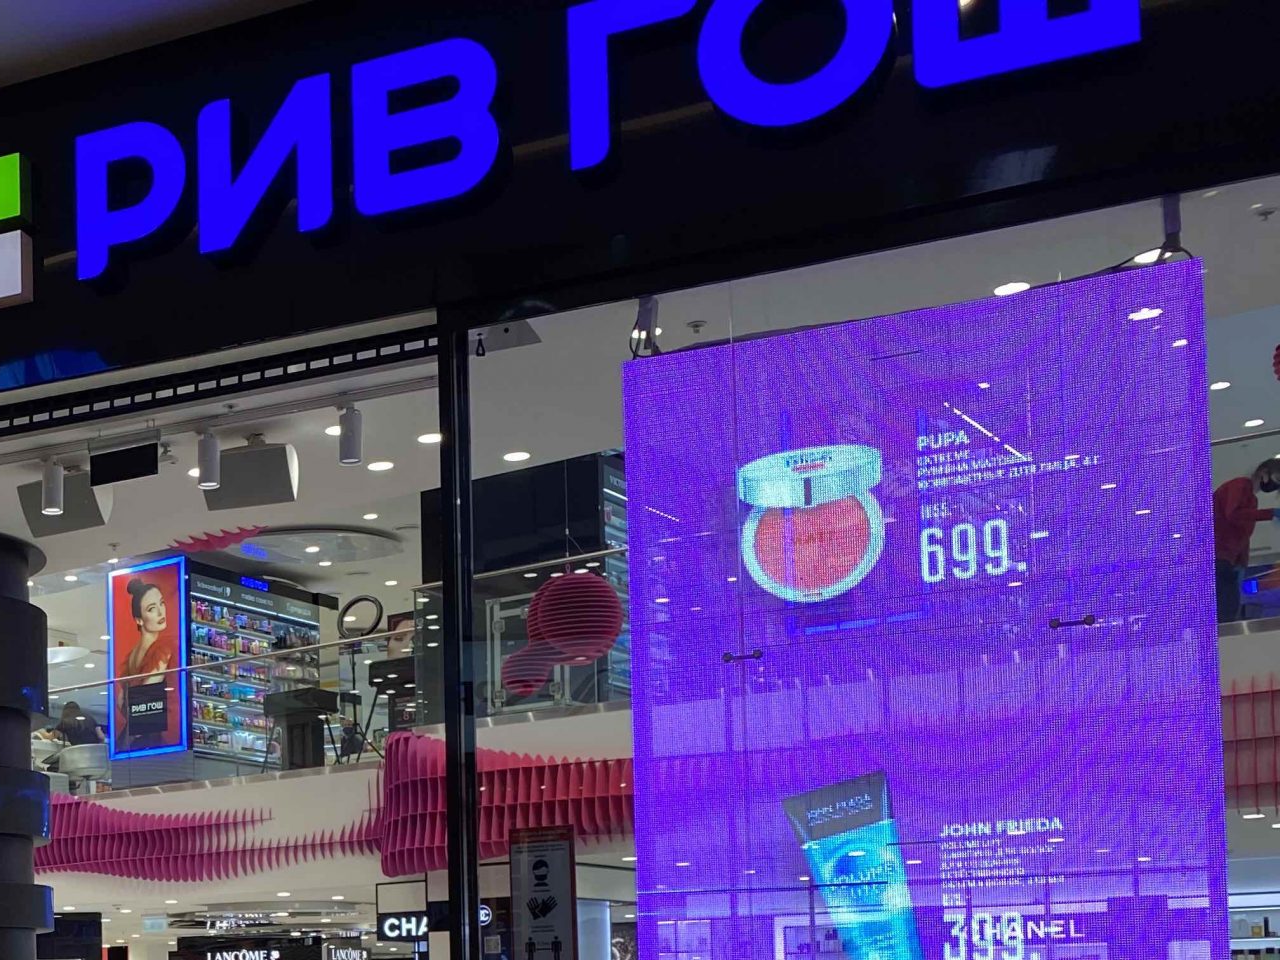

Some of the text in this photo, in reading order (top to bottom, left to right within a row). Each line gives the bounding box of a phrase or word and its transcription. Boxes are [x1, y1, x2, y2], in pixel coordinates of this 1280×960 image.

[76, 38, 501, 281] РИВ
[917, 430, 970, 451] PUPA
[940, 816, 1064, 838] JOHN FRIEDA
